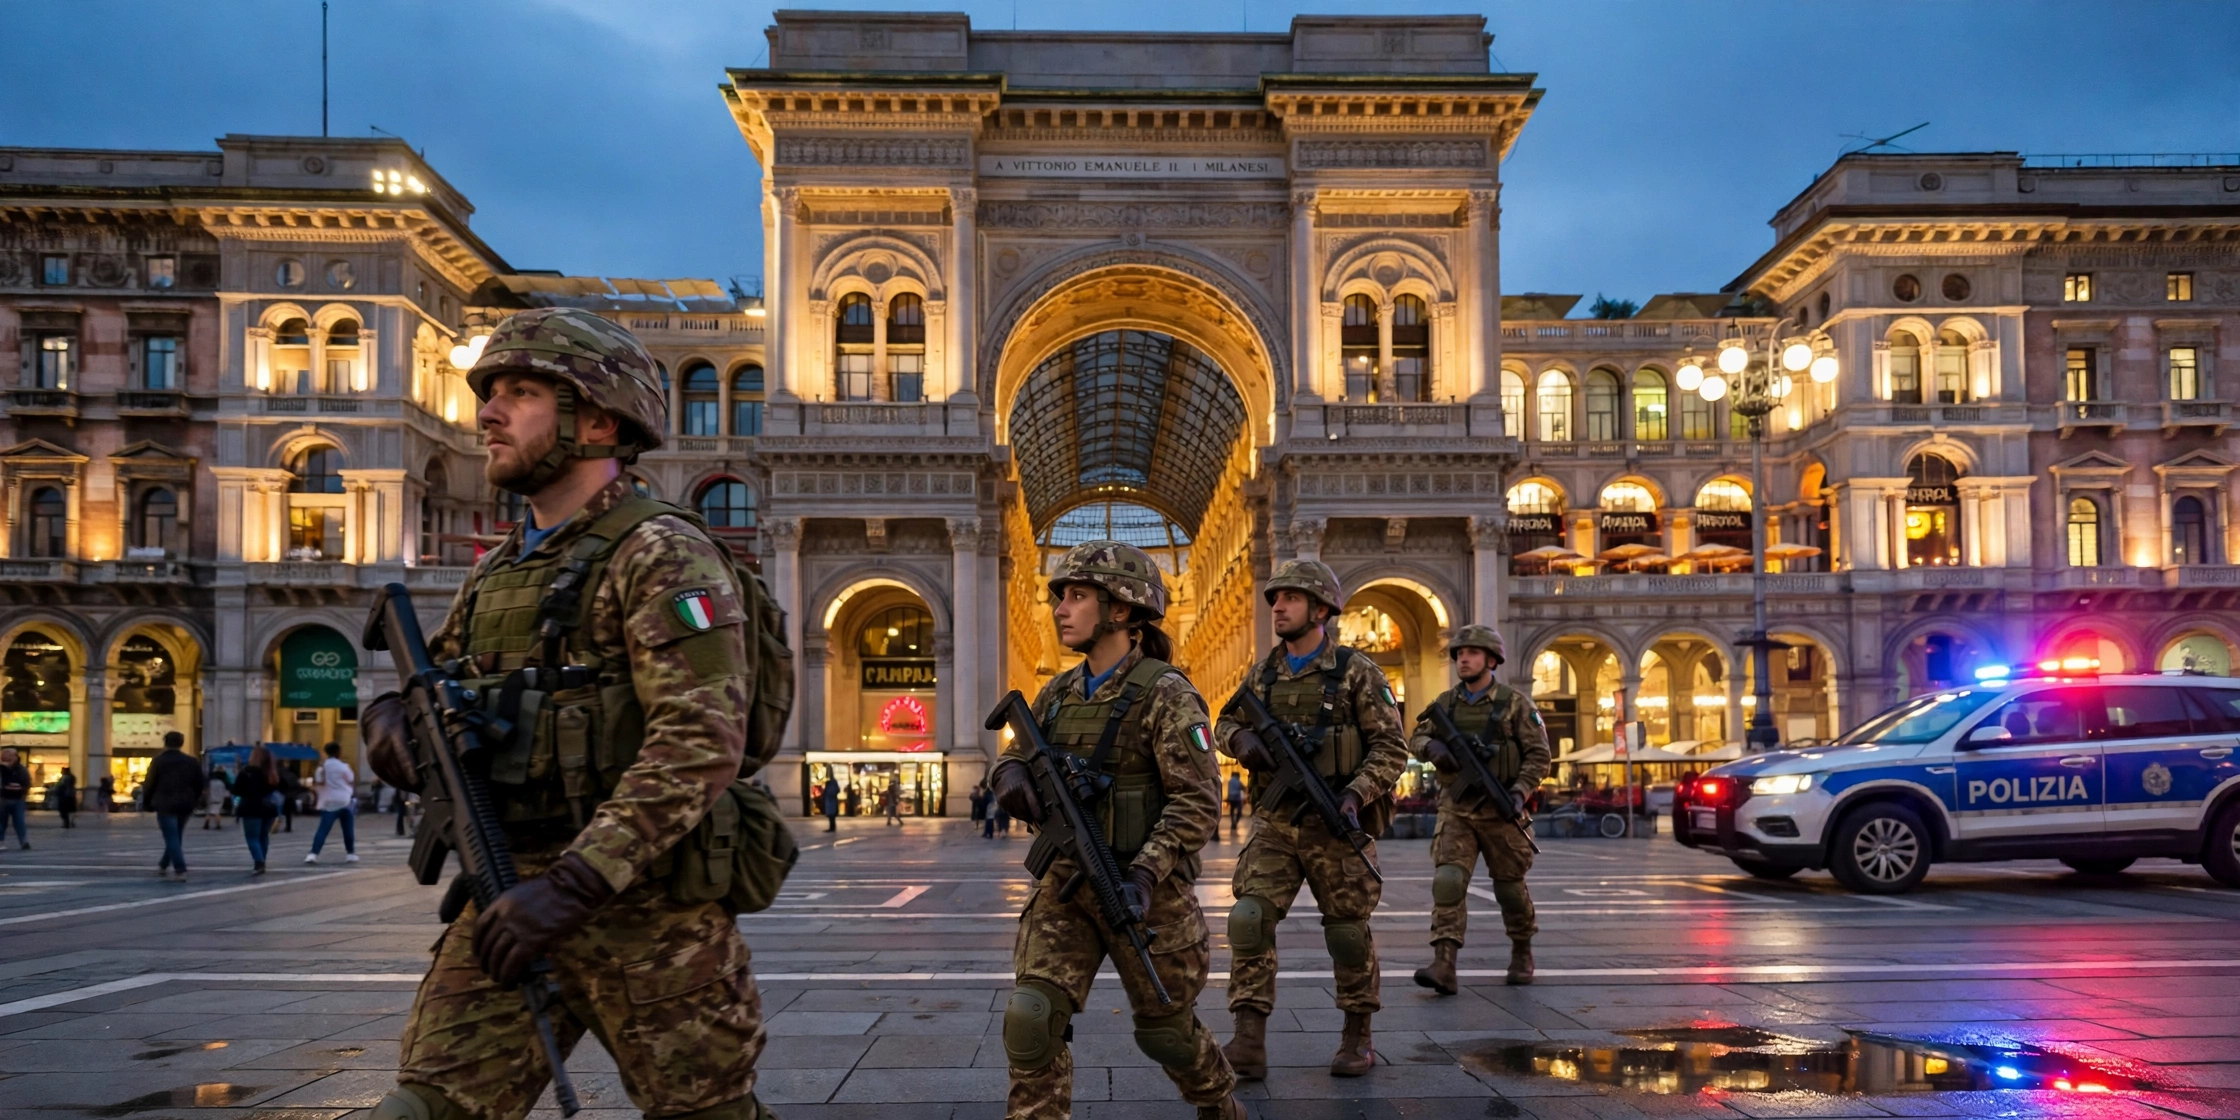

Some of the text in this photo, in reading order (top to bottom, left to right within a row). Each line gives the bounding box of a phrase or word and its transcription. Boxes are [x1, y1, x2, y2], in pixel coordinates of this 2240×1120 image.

[995, 161, 1003, 171] A
[1084, 161, 1161, 172] EMANUELE
[1968, 775, 2088, 804] POLIZIA
